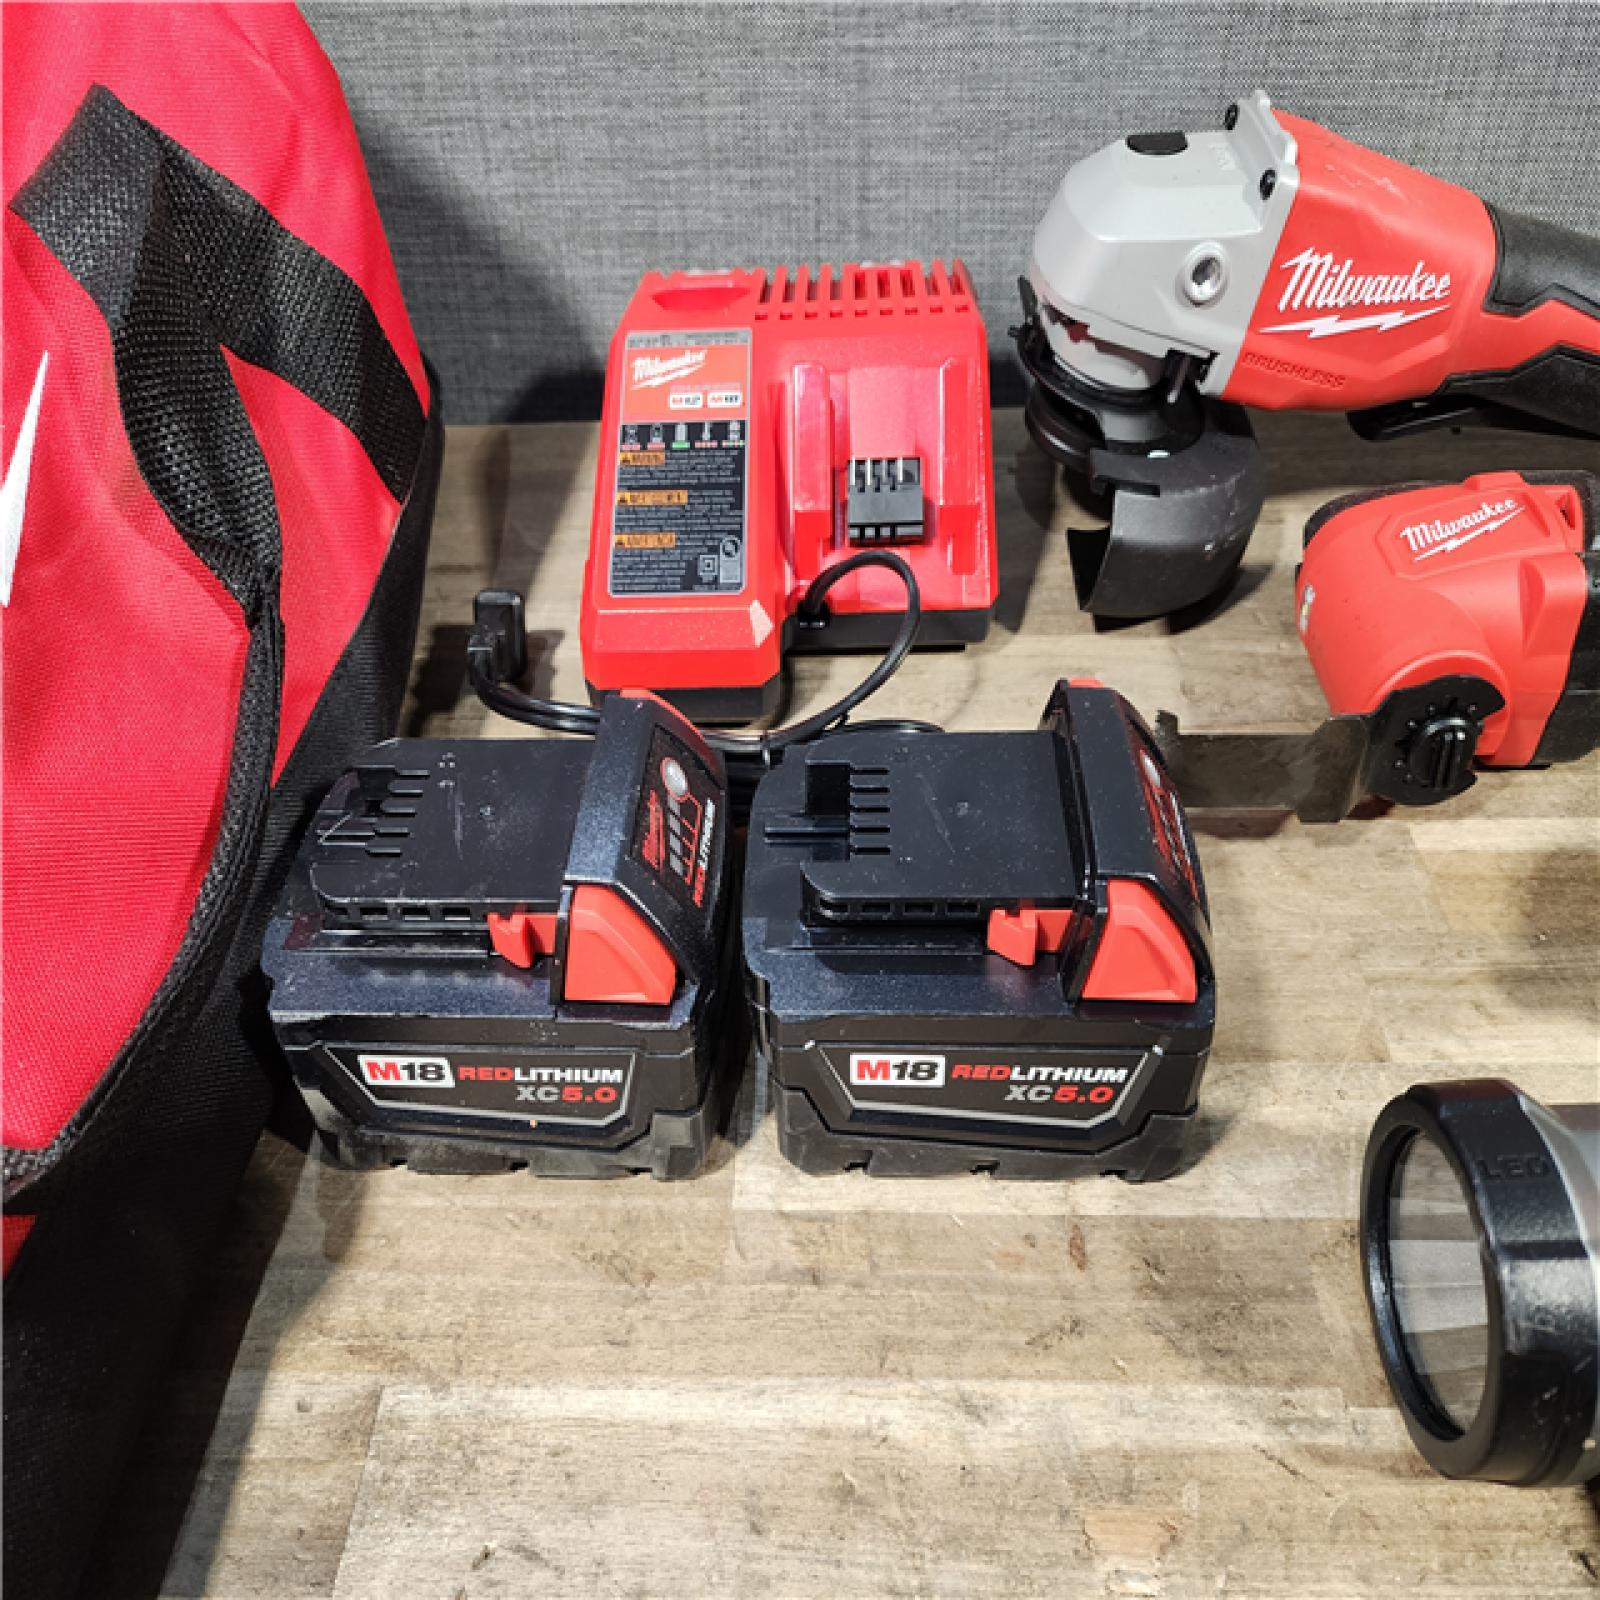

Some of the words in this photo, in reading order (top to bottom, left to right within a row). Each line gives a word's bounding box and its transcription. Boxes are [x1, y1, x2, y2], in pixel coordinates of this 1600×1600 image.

[1278, 247, 1451, 313] Milwaukee
[1240, 351, 1347, 390] BRUSHLESS
[1400, 499, 1516, 551] Milwaukee
[364, 1060, 446, 1082] M18
[457, 1066, 624, 1084] REDLITHIUM
[856, 1058, 940, 1081] M18
[951, 1063, 1129, 1082] REDLITHIUM
[1479, 1152, 1550, 1178] LED
